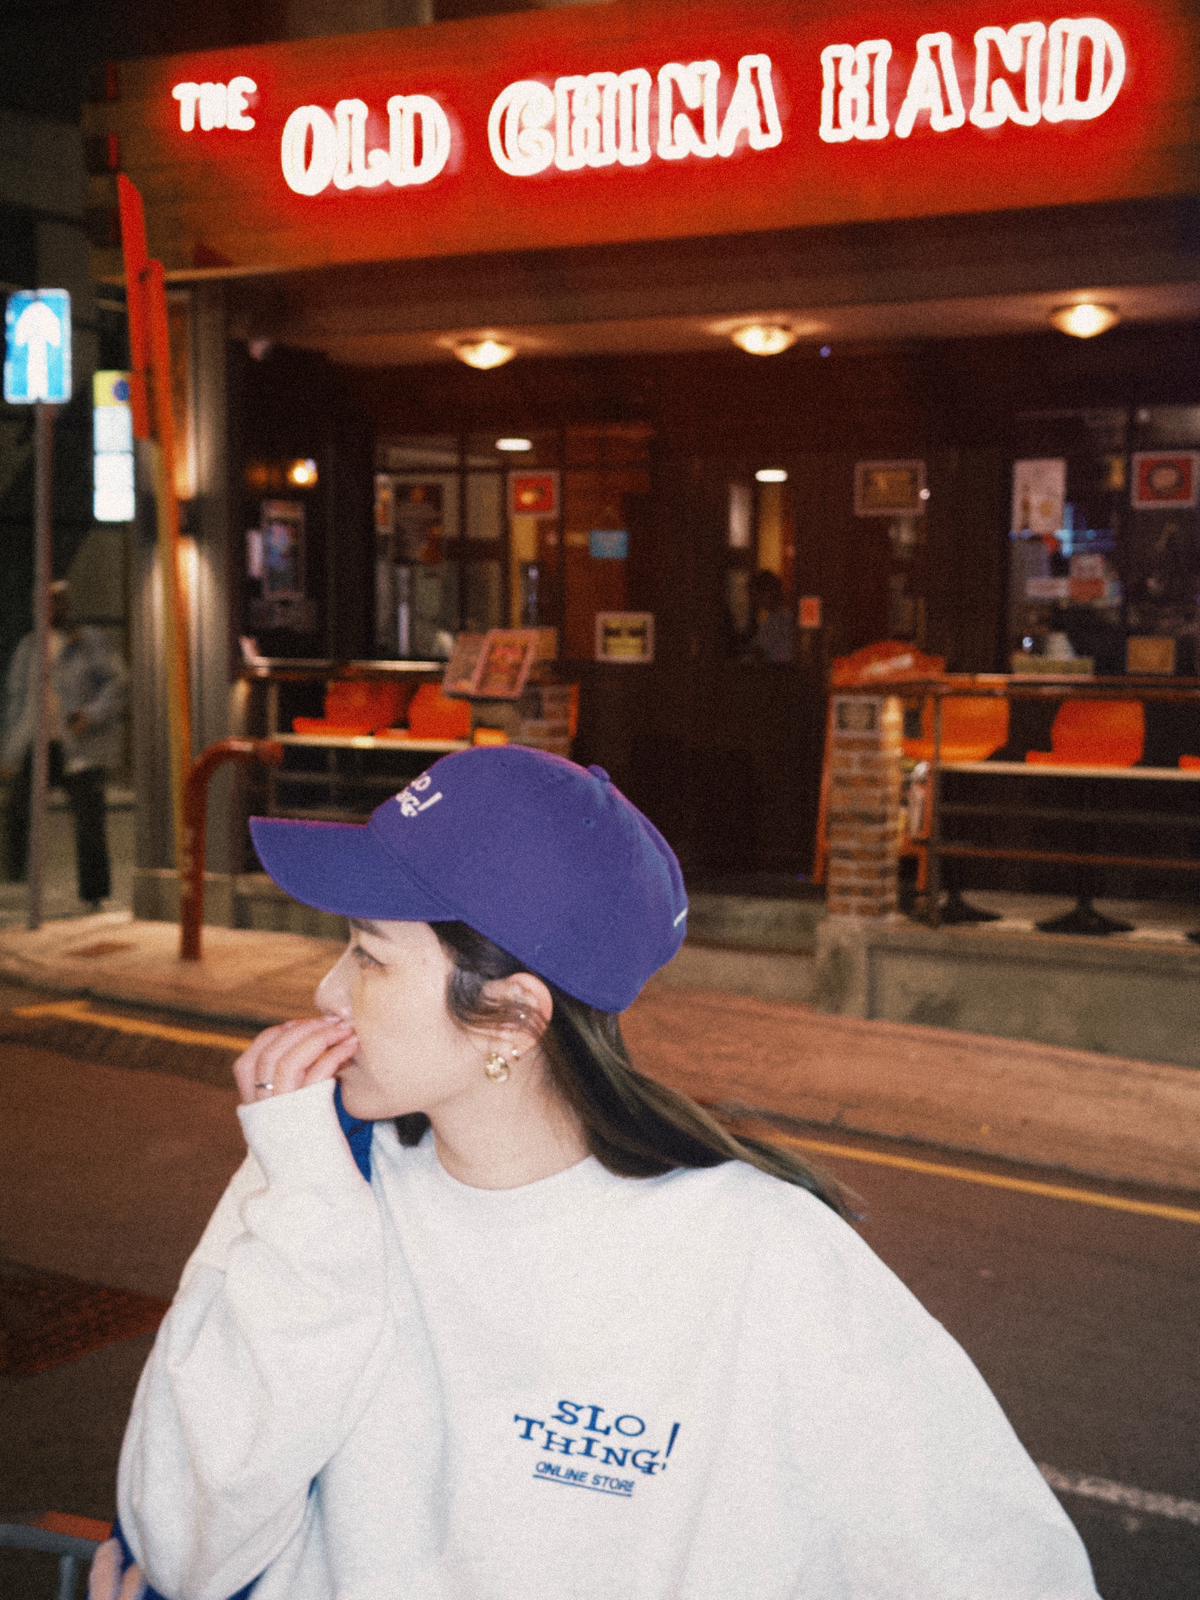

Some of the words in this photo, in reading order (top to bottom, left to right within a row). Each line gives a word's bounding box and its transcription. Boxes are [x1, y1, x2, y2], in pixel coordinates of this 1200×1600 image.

[172, 76, 257, 132] THE
[281, 94, 452, 196] OLD
[487, 54, 783, 177] CHINA
[818, 17, 1126, 143] HAND
[551, 1400, 646, 1437] SLO
[513, 1414, 680, 1475] THING!
[535, 1461, 588, 1482] ONLINE
[592, 1474, 635, 1493] STORE
